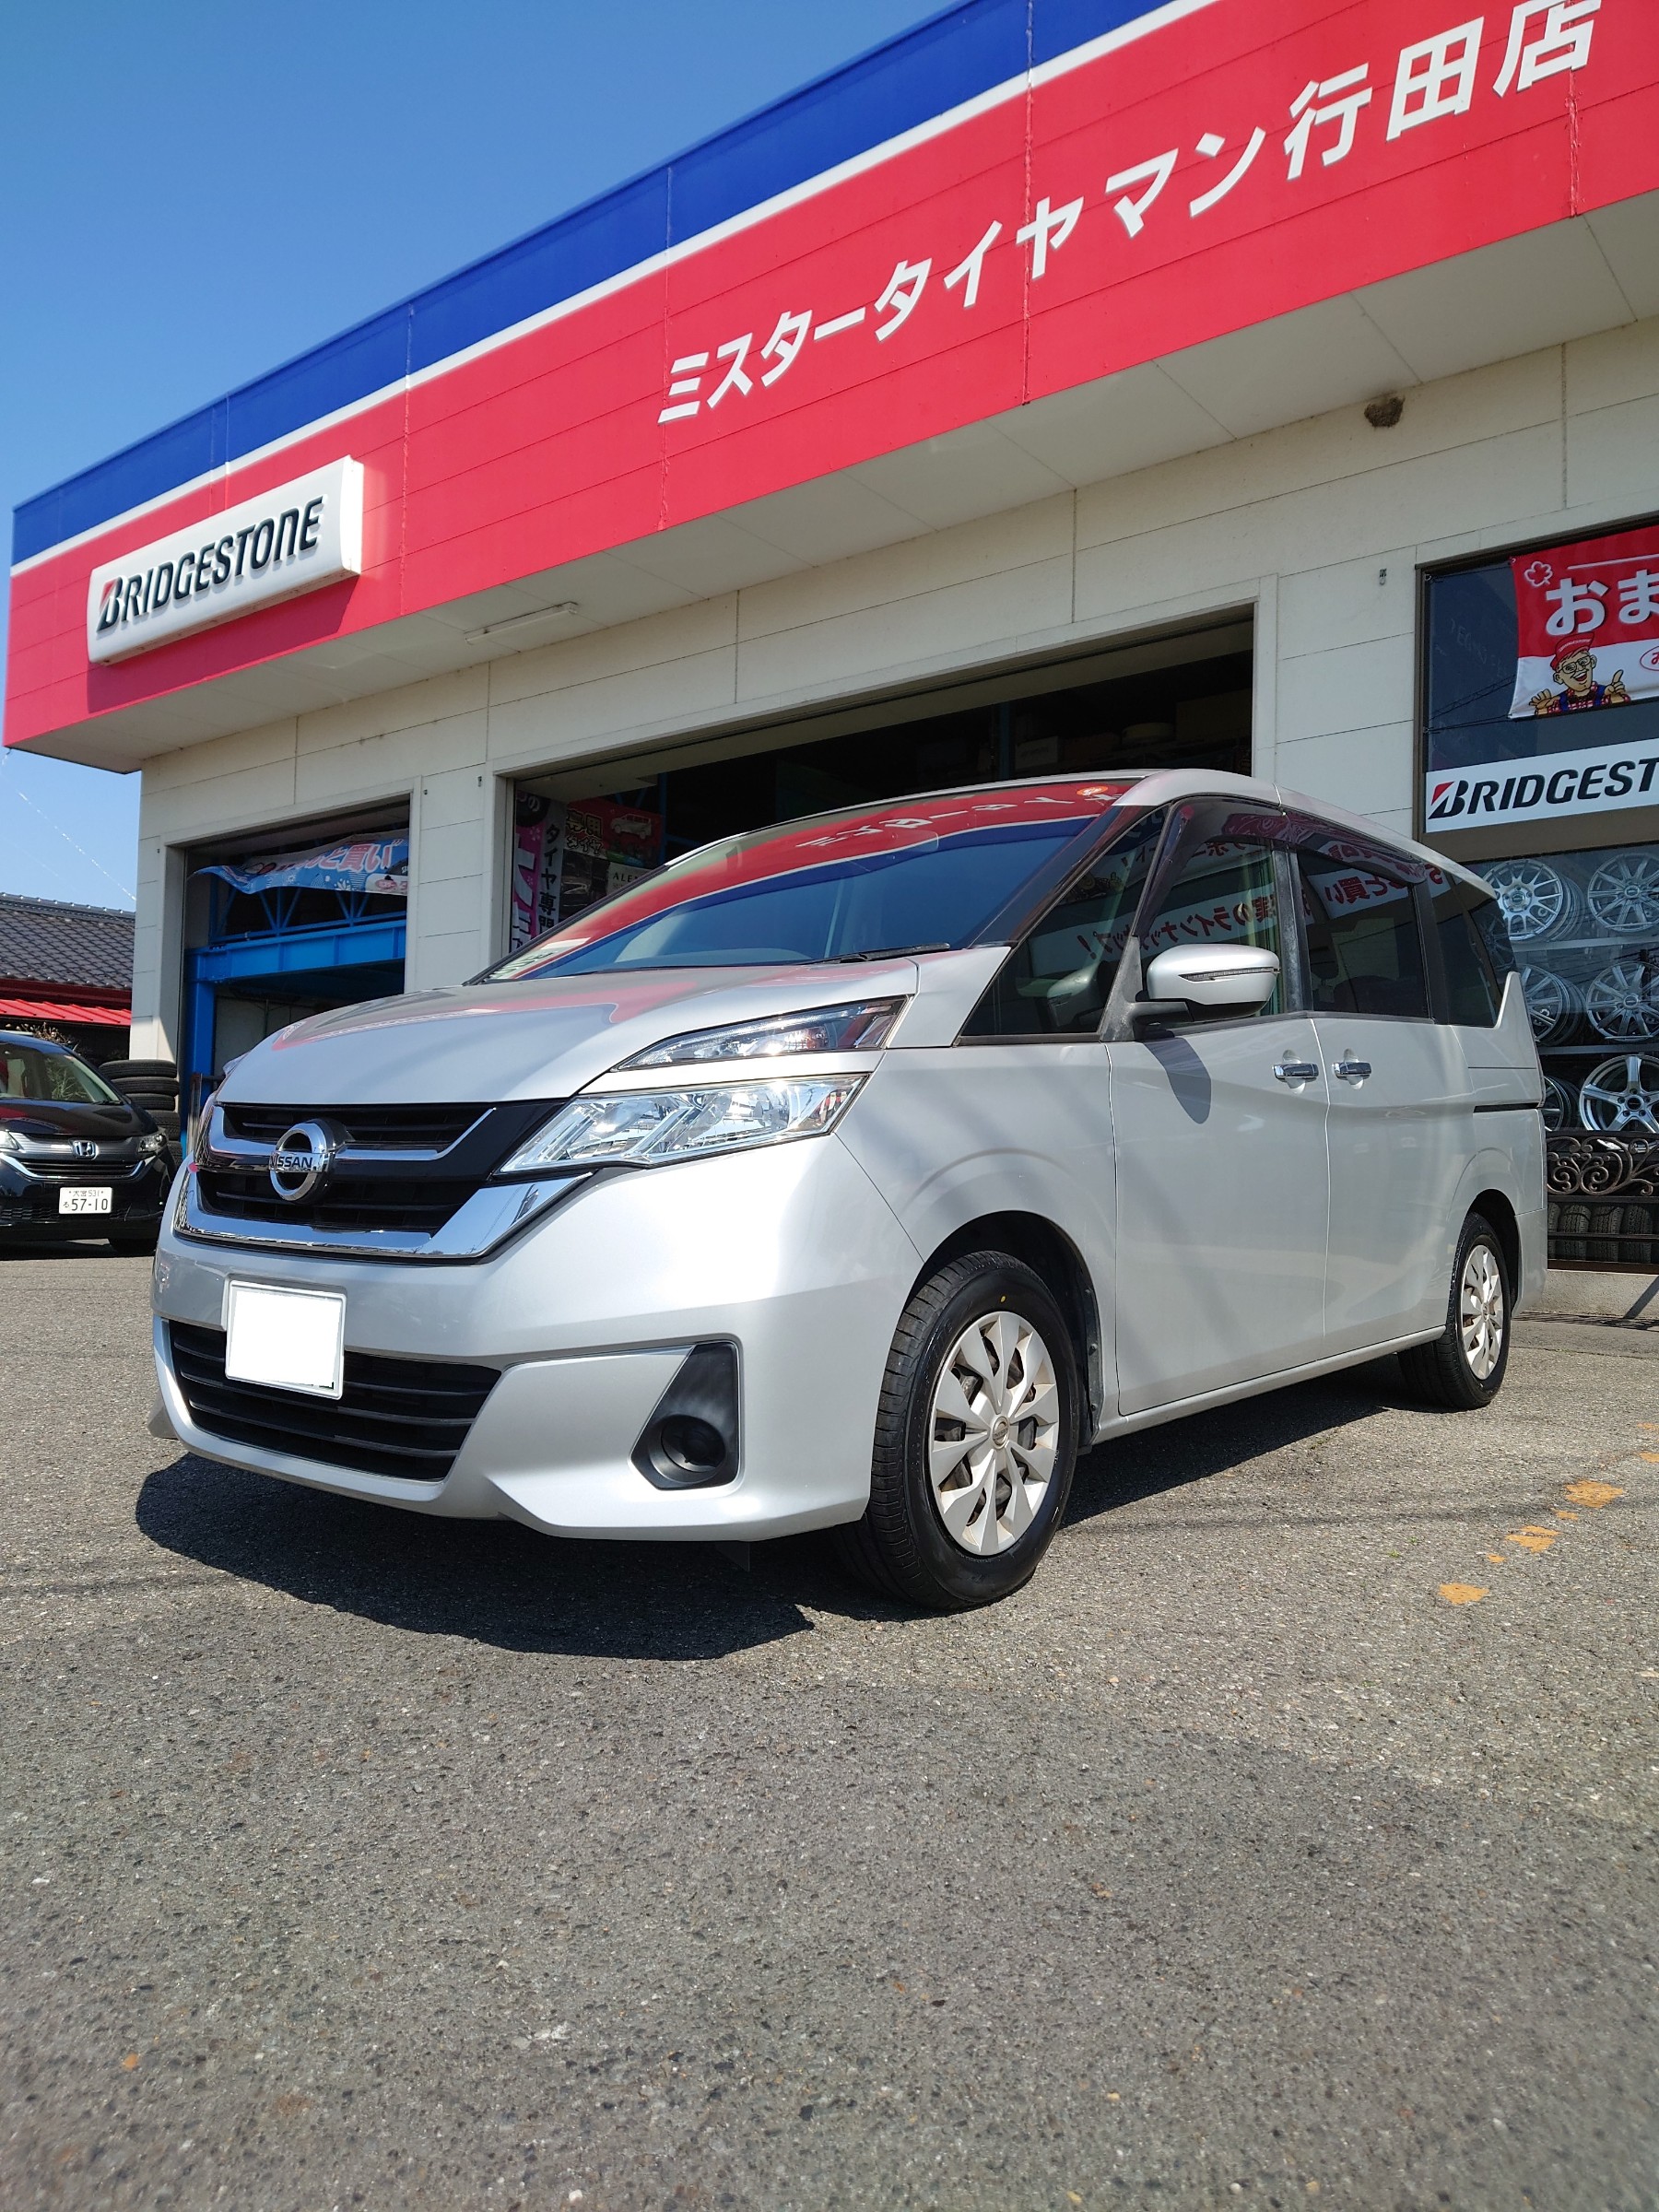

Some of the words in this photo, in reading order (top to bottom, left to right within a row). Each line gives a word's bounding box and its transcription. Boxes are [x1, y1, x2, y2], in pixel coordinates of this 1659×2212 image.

[657, 0, 1602, 425] ミスタータイヤマン行田店
[97, 495, 324, 632] BRIDGESTONE
[270, 1153, 313, 1169] NISSAN
[71, 1198, 109, 1211] 57-10
